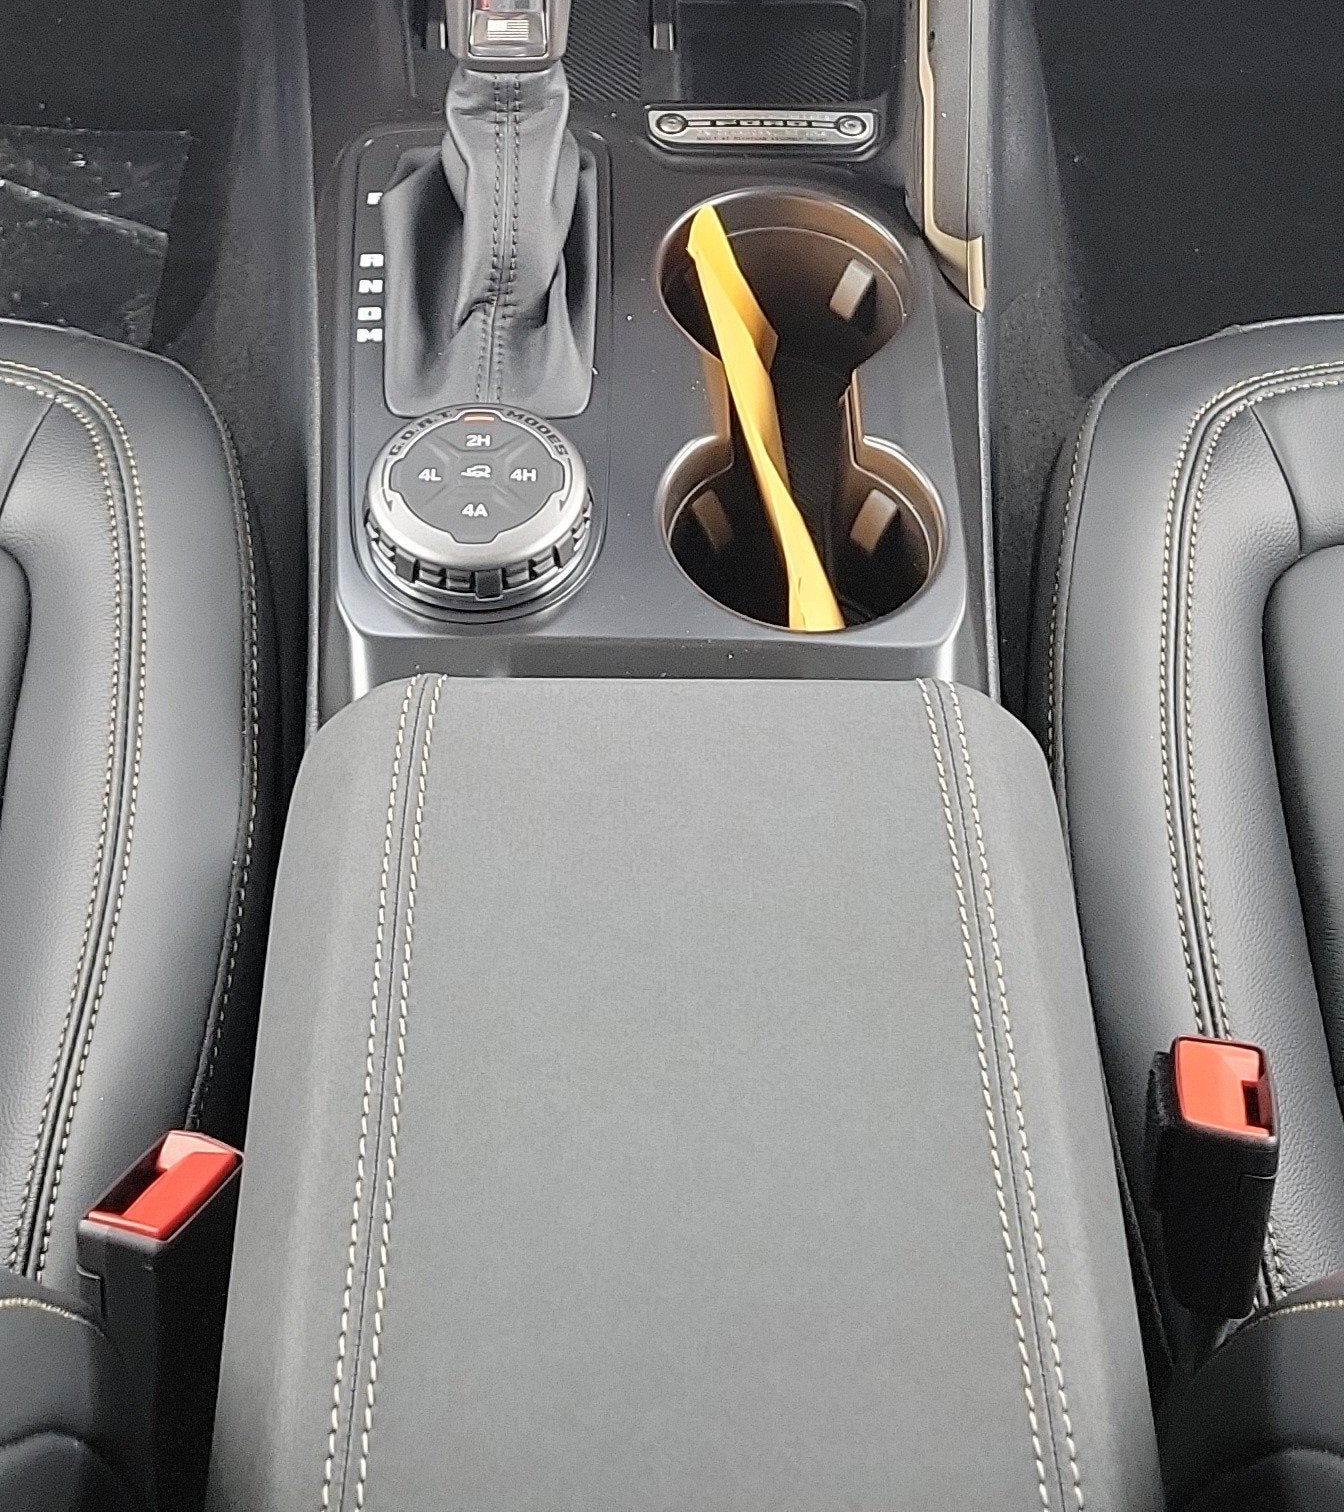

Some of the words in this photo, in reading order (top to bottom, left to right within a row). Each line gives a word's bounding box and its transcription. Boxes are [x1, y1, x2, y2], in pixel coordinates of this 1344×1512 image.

[358, 279, 383, 294] N
[356, 328, 383, 343] M
[506, 410, 569, 456] MODES
[466, 434, 490, 447] 2H
[418, 468, 442, 481] 4L
[510, 468, 537, 481] 4H
[462, 503, 488, 517] 4A
